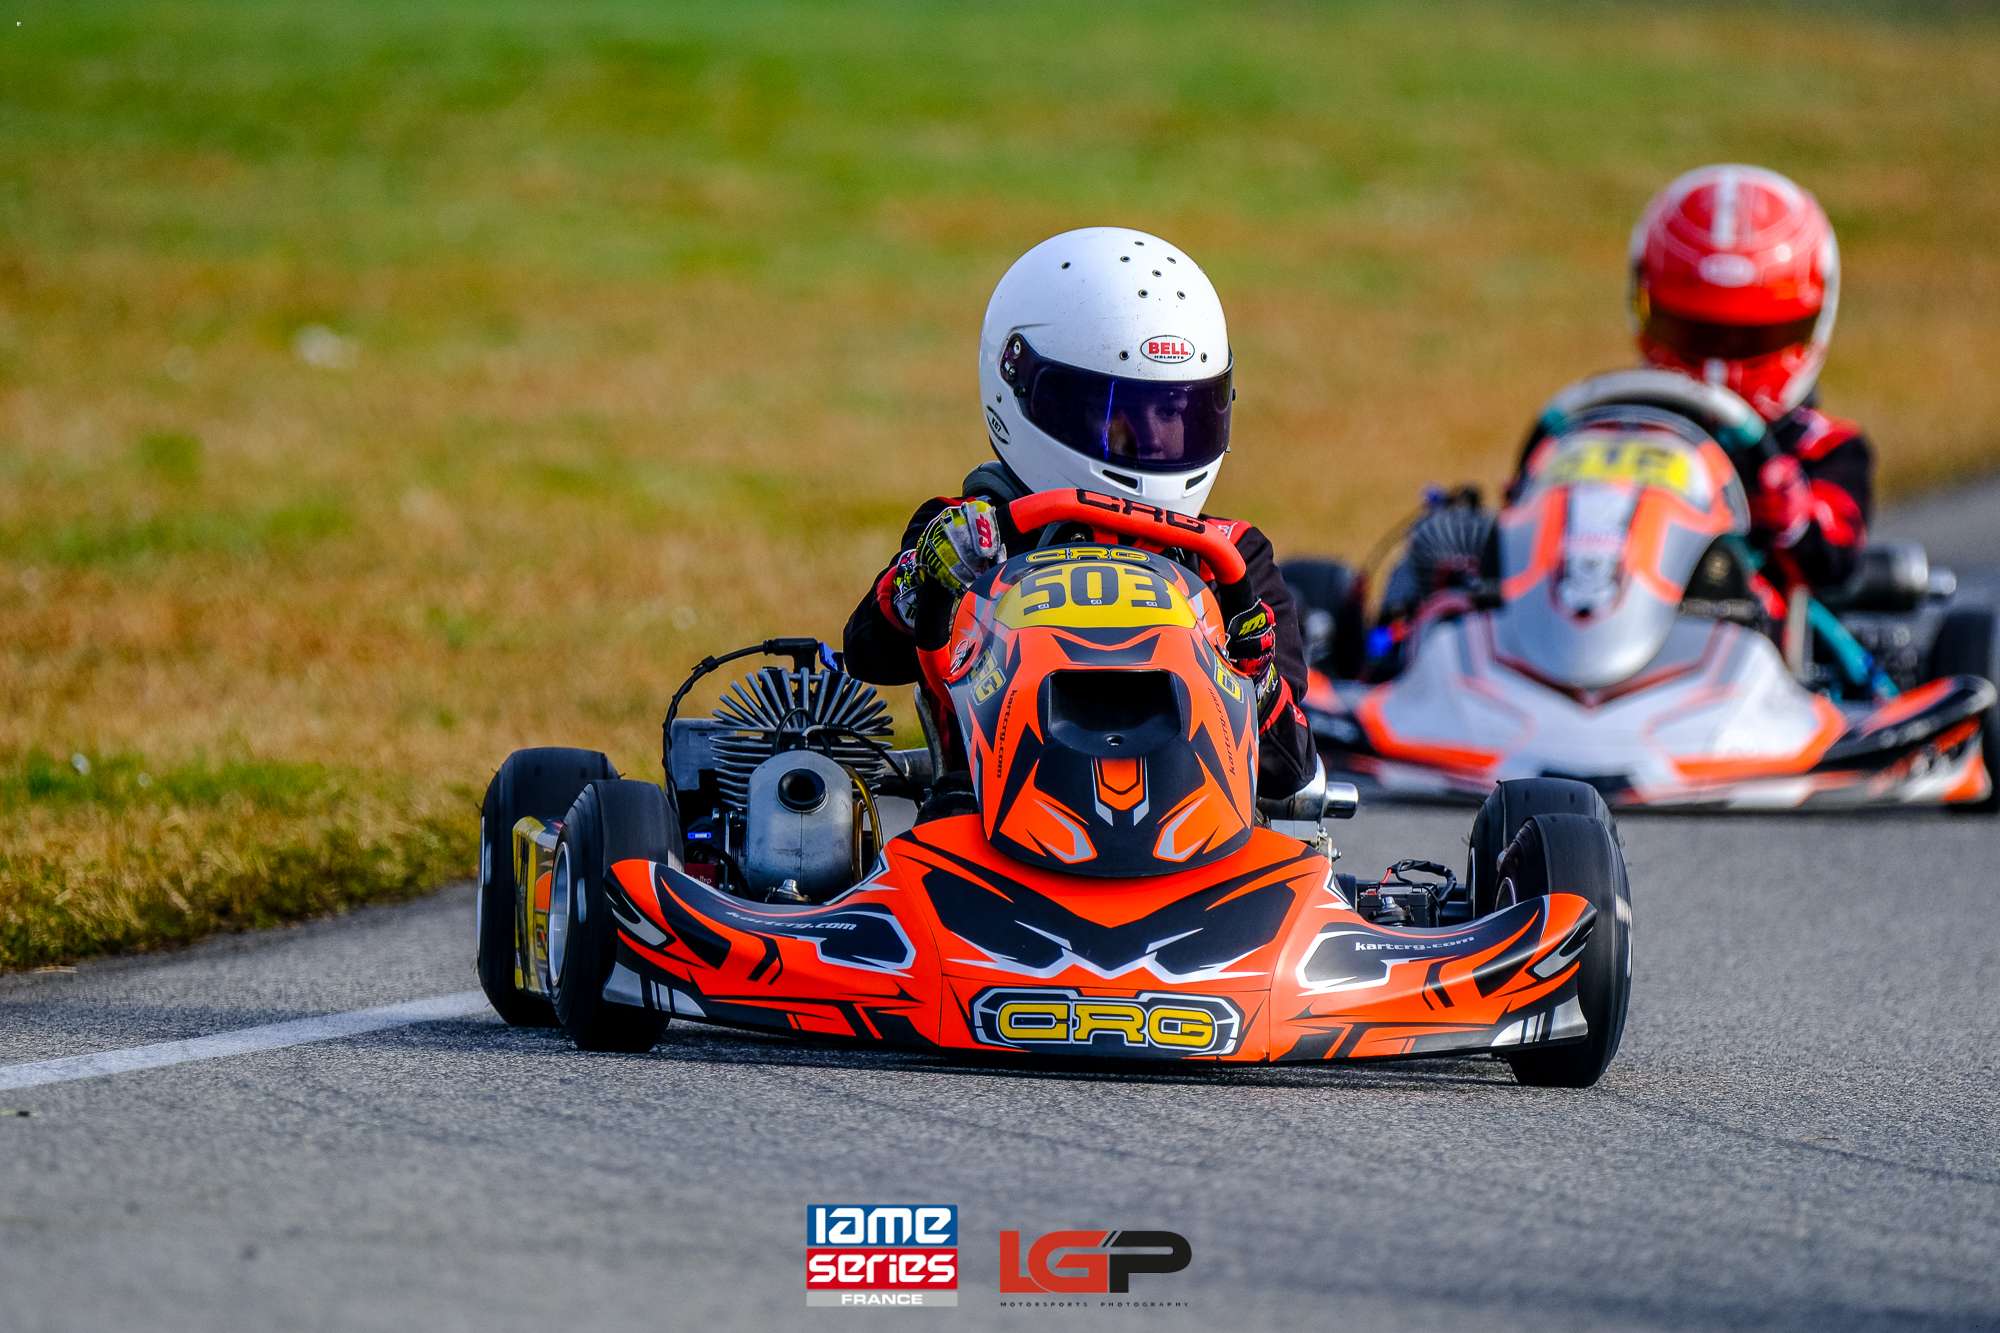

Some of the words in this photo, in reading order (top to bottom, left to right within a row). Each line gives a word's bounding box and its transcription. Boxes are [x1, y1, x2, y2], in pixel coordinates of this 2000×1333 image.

[1148, 342, 1191, 355] BELL
[1076, 488, 1206, 534] CRG
[1026, 547, 1150, 563] CRG
[1020, 566, 1172, 616] 503
[1355, 936, 1475, 951] kartcrg.com
[996, 1000, 1217, 1052] CRG
